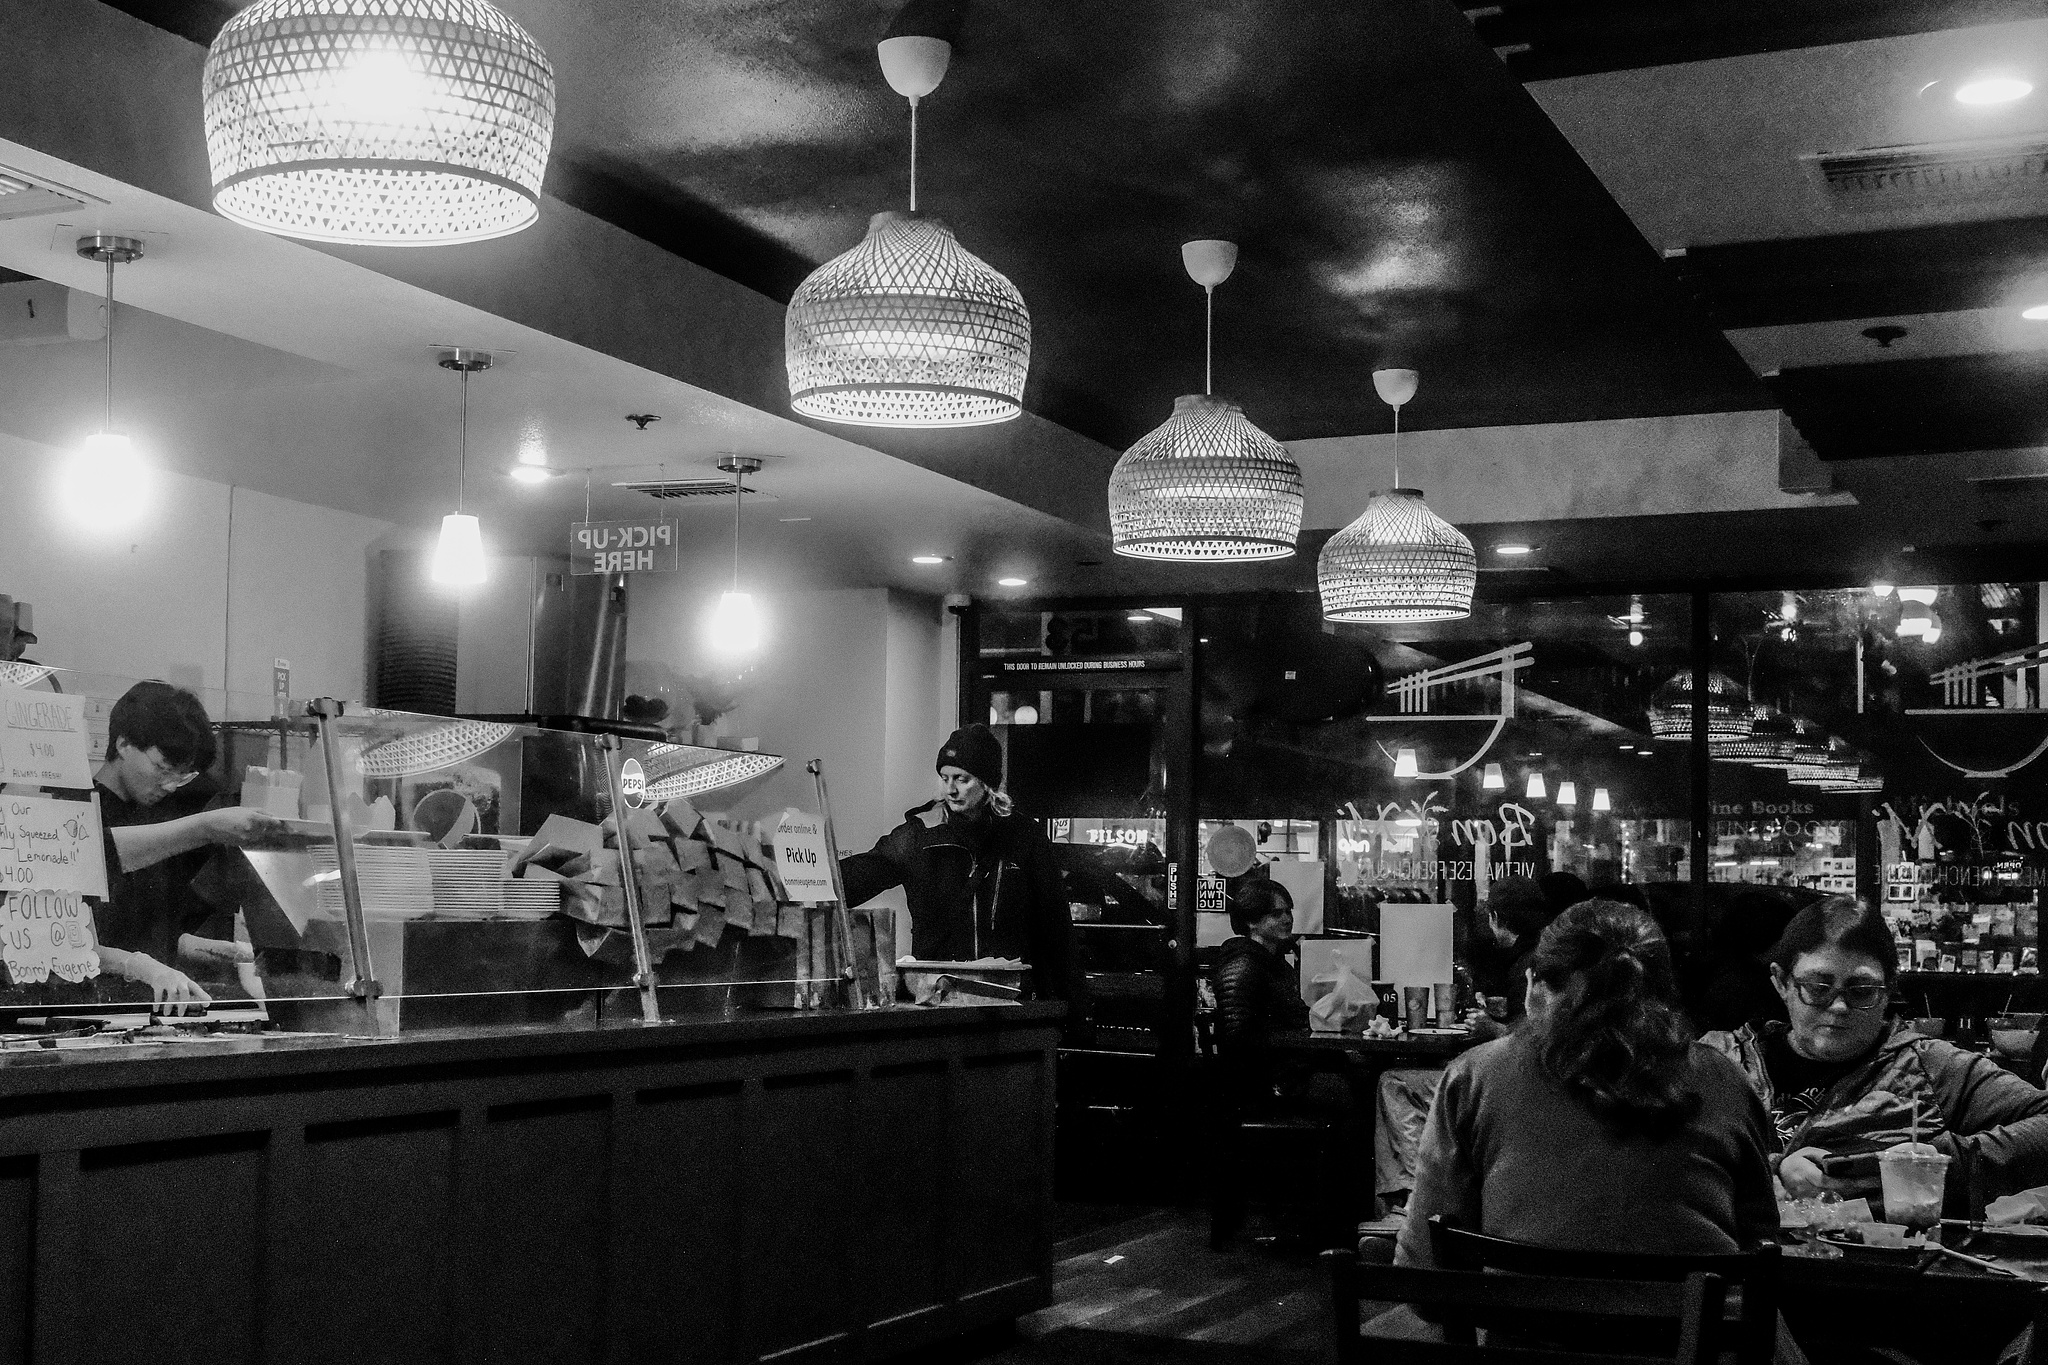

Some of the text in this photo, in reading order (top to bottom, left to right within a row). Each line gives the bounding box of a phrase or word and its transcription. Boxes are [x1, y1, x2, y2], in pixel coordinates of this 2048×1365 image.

[1004, 660, 1146, 671] THIS DOOR TO REMAIN UNLOCKED DURING BUSINESS HOURS
[5, 699, 76, 731] GINGERADE
[13, 768, 38, 778] ALWAYS
[623, 778, 644, 790] PEPSI
[12, 802, 31, 816] Our
[19, 824, 60, 849] Squeezed
[793, 823, 812, 835] online
[812, 823, 818, 835] &
[785, 847, 817, 868] Pick Up
[1169, 867, 1178, 898] PUSH
[9, 894, 78, 921] FOLLOW
[10, 927, 31, 950] US
[51, 956, 96, 980] Eugene
[1383, 993, 1397, 1003] 05
[1959, 1017, 1971, 1030] 11
